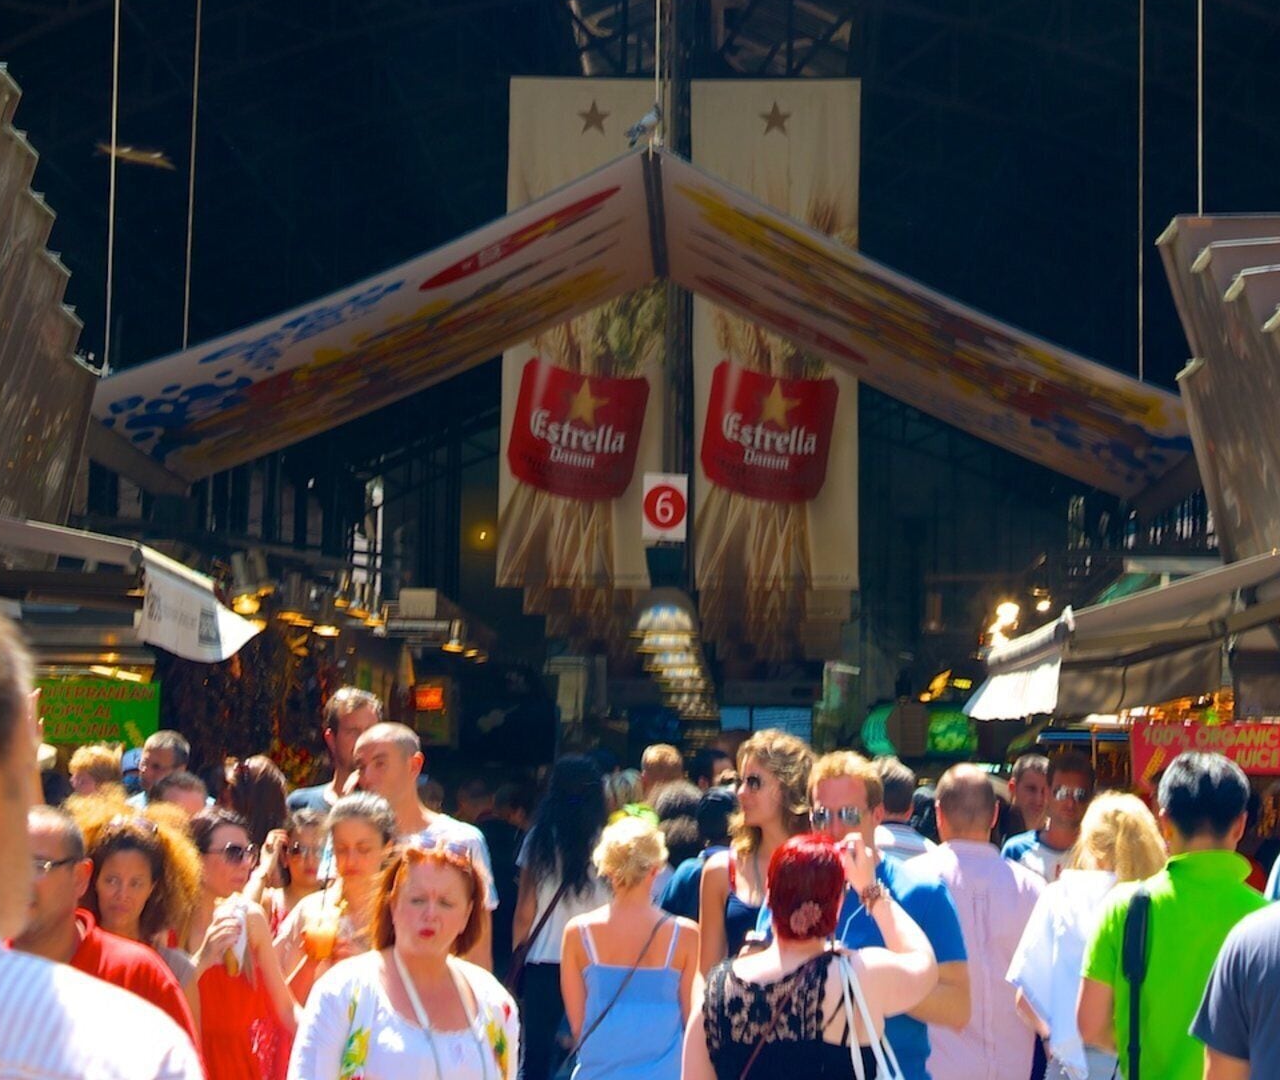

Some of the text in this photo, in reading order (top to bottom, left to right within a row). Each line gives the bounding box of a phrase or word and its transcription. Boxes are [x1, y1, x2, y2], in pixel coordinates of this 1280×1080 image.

[530, 408, 626, 454] Estrella
[722, 410, 818, 456] Estrella
[549, 446, 596, 469] Damm
[743, 448, 790, 471] Damm
[654, 491, 674, 524] 6
[41, 684, 155, 700] DITERRANEAN
[40, 703, 112, 719] ROPICAL
[1143, 726, 1279, 748] 100% ORGANIC
